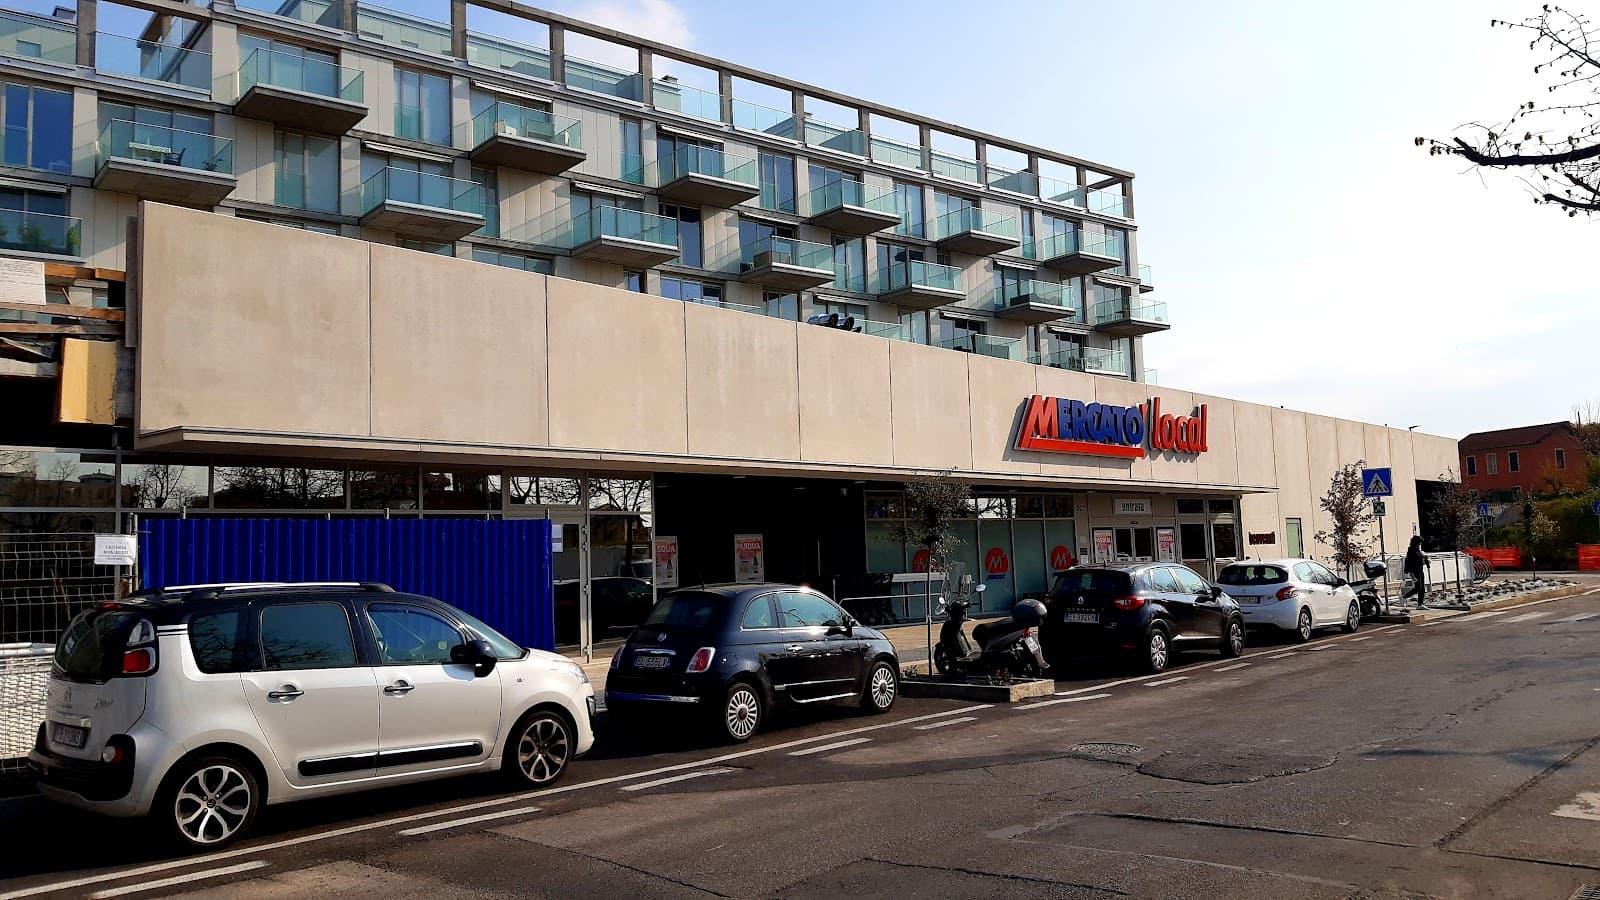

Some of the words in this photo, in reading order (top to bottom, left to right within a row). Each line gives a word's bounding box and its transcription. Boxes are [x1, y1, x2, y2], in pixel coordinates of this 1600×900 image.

[1151, 397, 1208, 452] local
[1121, 501, 1145, 512] entrata
[656, 545, 676, 553] SQUA
[736, 542, 761, 551] PASQUA
